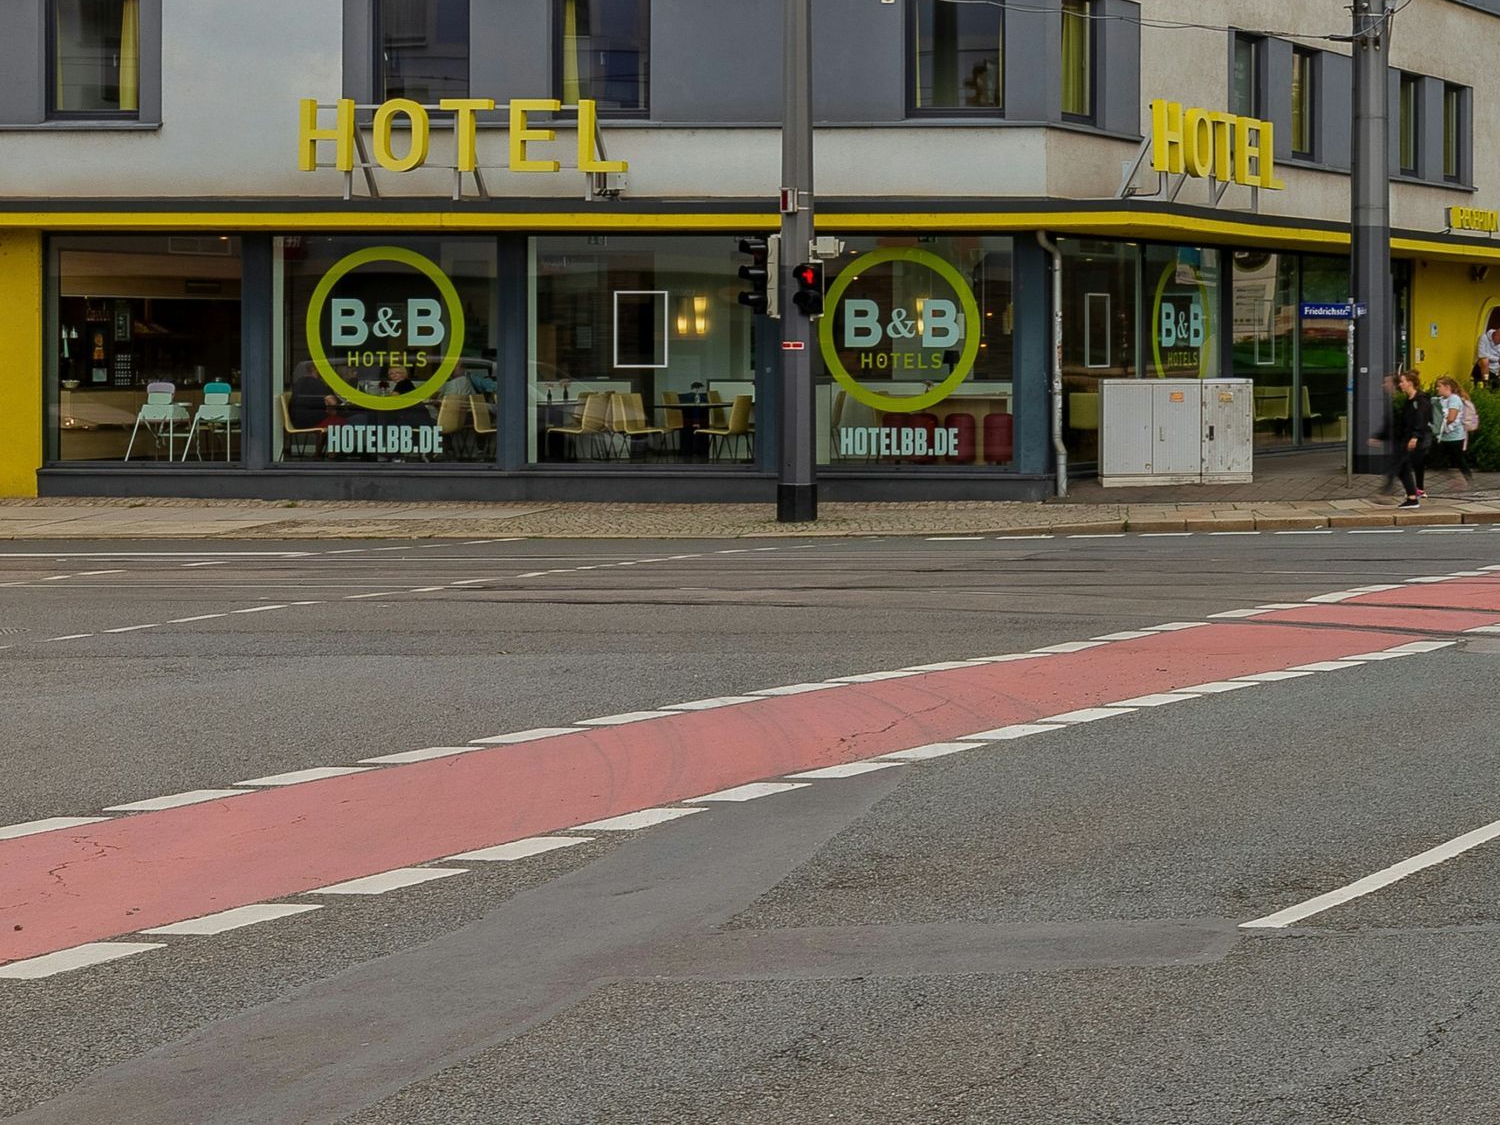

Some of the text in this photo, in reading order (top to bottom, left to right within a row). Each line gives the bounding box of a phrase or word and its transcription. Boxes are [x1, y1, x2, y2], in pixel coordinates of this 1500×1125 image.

[300, 99, 628, 173] HOTEL
[1152, 98, 1285, 190] HOTEL
[331, 298, 445, 346] B&B
[844, 299, 960, 348] B&B
[1161, 302, 1204, 347] B&B
[1304, 306, 1348, 315] Friedrichstr.
[347, 351, 428, 367] HOTELS
[861, 352, 943, 369] HOTELS
[1167, 352, 1198, 366] HOTELS
[327, 425, 443, 453] HOTELBB.DE
[840, 427, 959, 456] HOTELBB.DE
